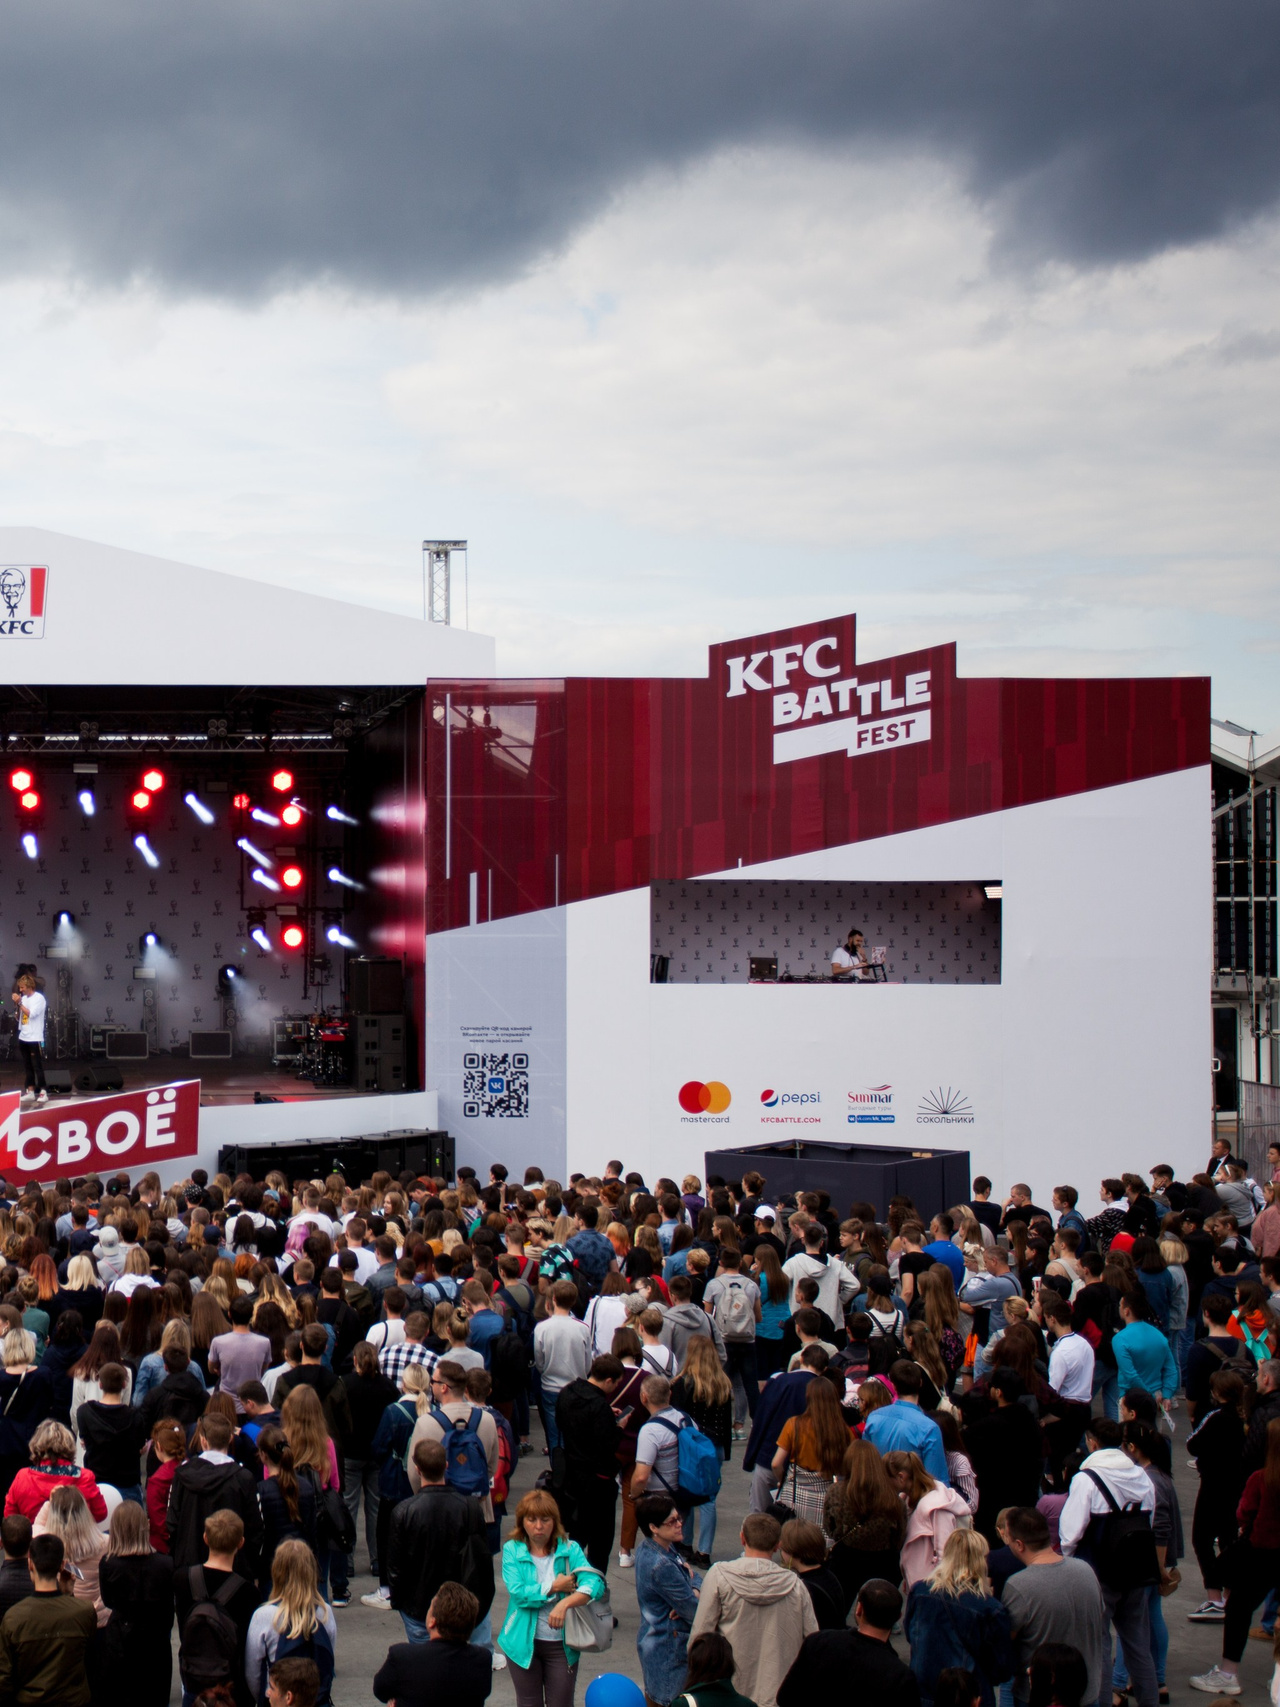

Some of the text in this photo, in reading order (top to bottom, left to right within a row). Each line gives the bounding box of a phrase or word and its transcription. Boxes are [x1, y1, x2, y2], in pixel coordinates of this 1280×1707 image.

[726, 637, 840, 698] KFC
[773, 670, 931, 726] BATTLE
[857, 719, 916, 749] FEST
[781, 1092, 821, 1105] pepsi
[848, 1091, 894, 1103] Sunmar
